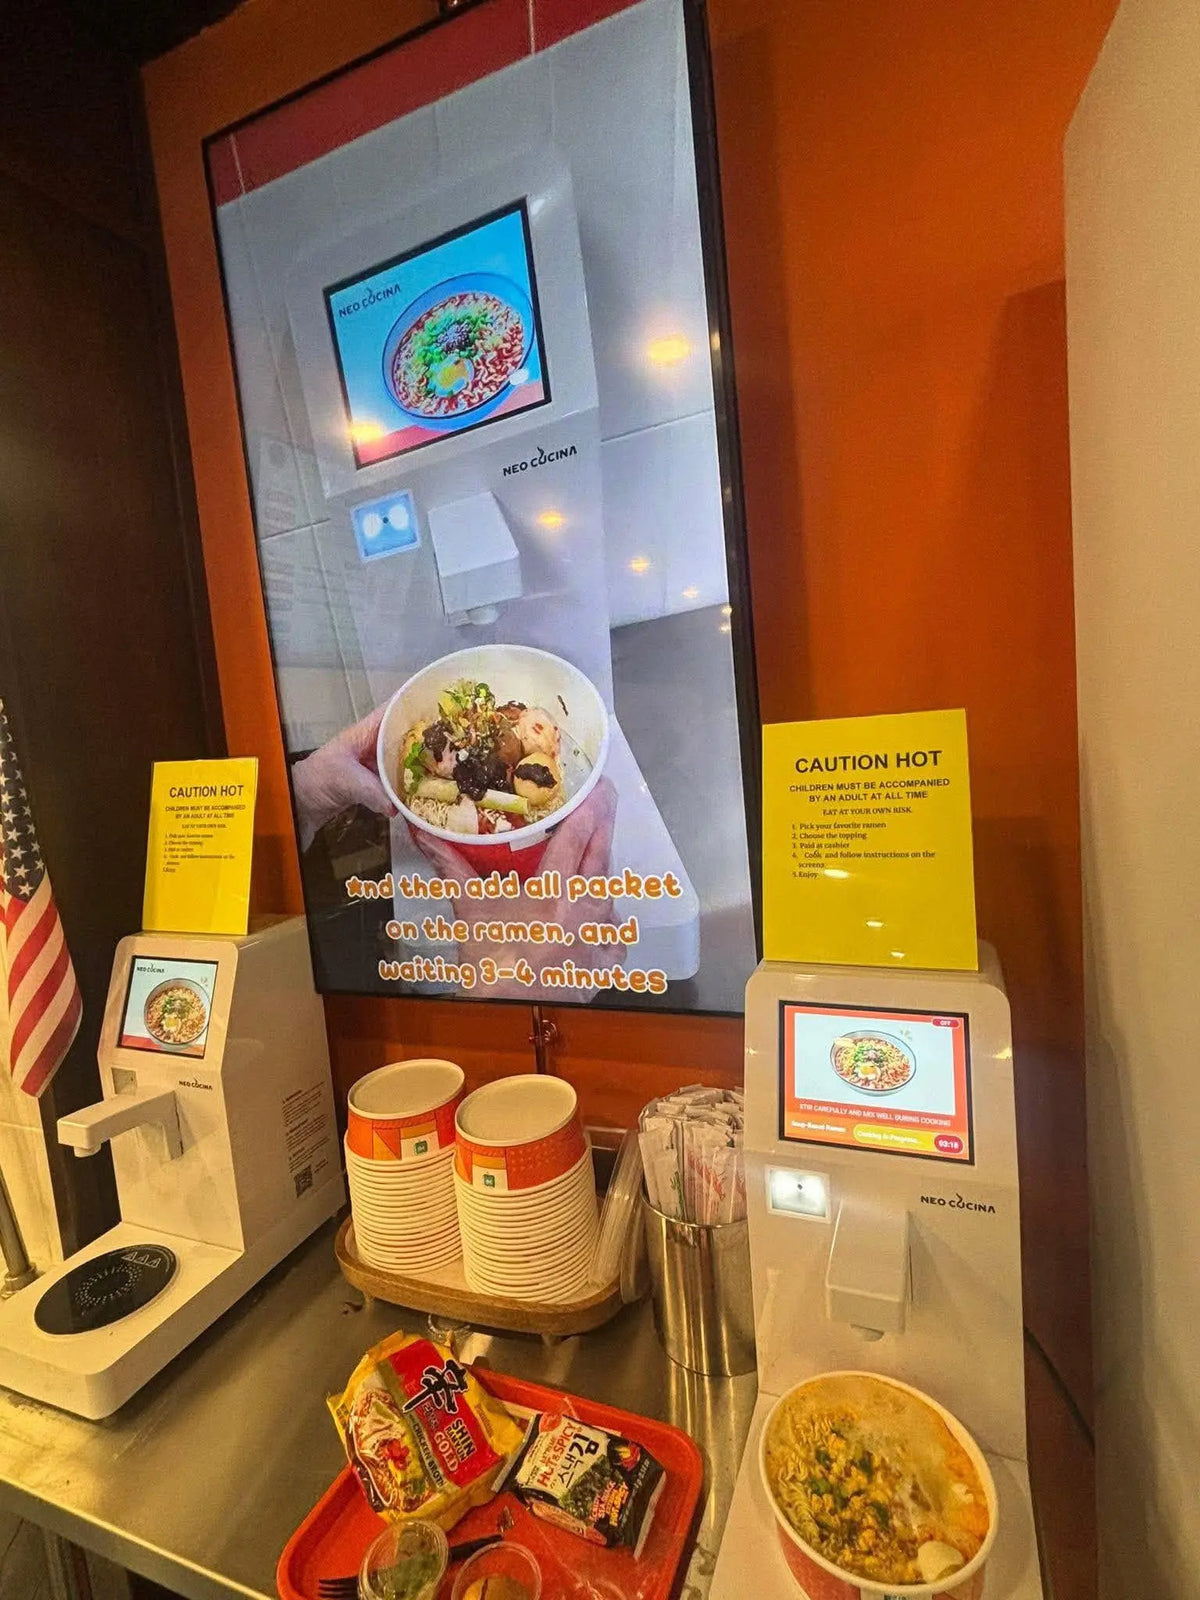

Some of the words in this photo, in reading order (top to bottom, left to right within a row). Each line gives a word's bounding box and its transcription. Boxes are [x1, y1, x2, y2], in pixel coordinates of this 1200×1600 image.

[339, 301, 360, 318] NEO
[503, 460, 529, 476] NEO
[795, 754, 888, 773] CAUTION
[896, 751, 942, 768] HOT
[169, 786, 217, 798] CAUTION
[221, 785, 244, 796] HOT
[790, 784, 834, 792] CHILDREN
[836, 782, 861, 791] MUST
[864, 782, 876, 790] BE
[879, 778, 950, 789] ACCOMPANIED
[824, 794, 836, 802] AN
[839, 793, 867, 801] ADULT
[870, 792, 882, 800] AT
[885, 792, 902, 800] ALL
[905, 791, 928, 799] TIME
[816, 823, 832, 831] your
[833, 822, 861, 830] favorite
[839, 832, 867, 840] topping
[840, 851, 862, 859] follow
[400, 872, 461, 899] then
[465, 871, 519, 899] add
[525, 870, 561, 898] all
[567, 869, 683, 902] packet
[385, 920, 418, 940] on
[423, 915, 469, 942] the
[474, 920, 575, 946] ramen,
[579, 916, 640, 945] and
[379, 956, 476, 988] waiting
[480, 958, 536, 985] 3-4
[541, 959, 668, 994] minutes
[814, 1105, 847, 1114] CAREFULLY
[876, 1112, 894, 1120] WELL
[920, 1195, 946, 1207] NEO
[403, 1359, 469, 1414] 辛
[451, 1419, 475, 1456] SHIN
[413, 1422, 430, 1460] CHICKEN
[428, 1460, 446, 1487] BROTH
[434, 1431, 459, 1472] GOLD
